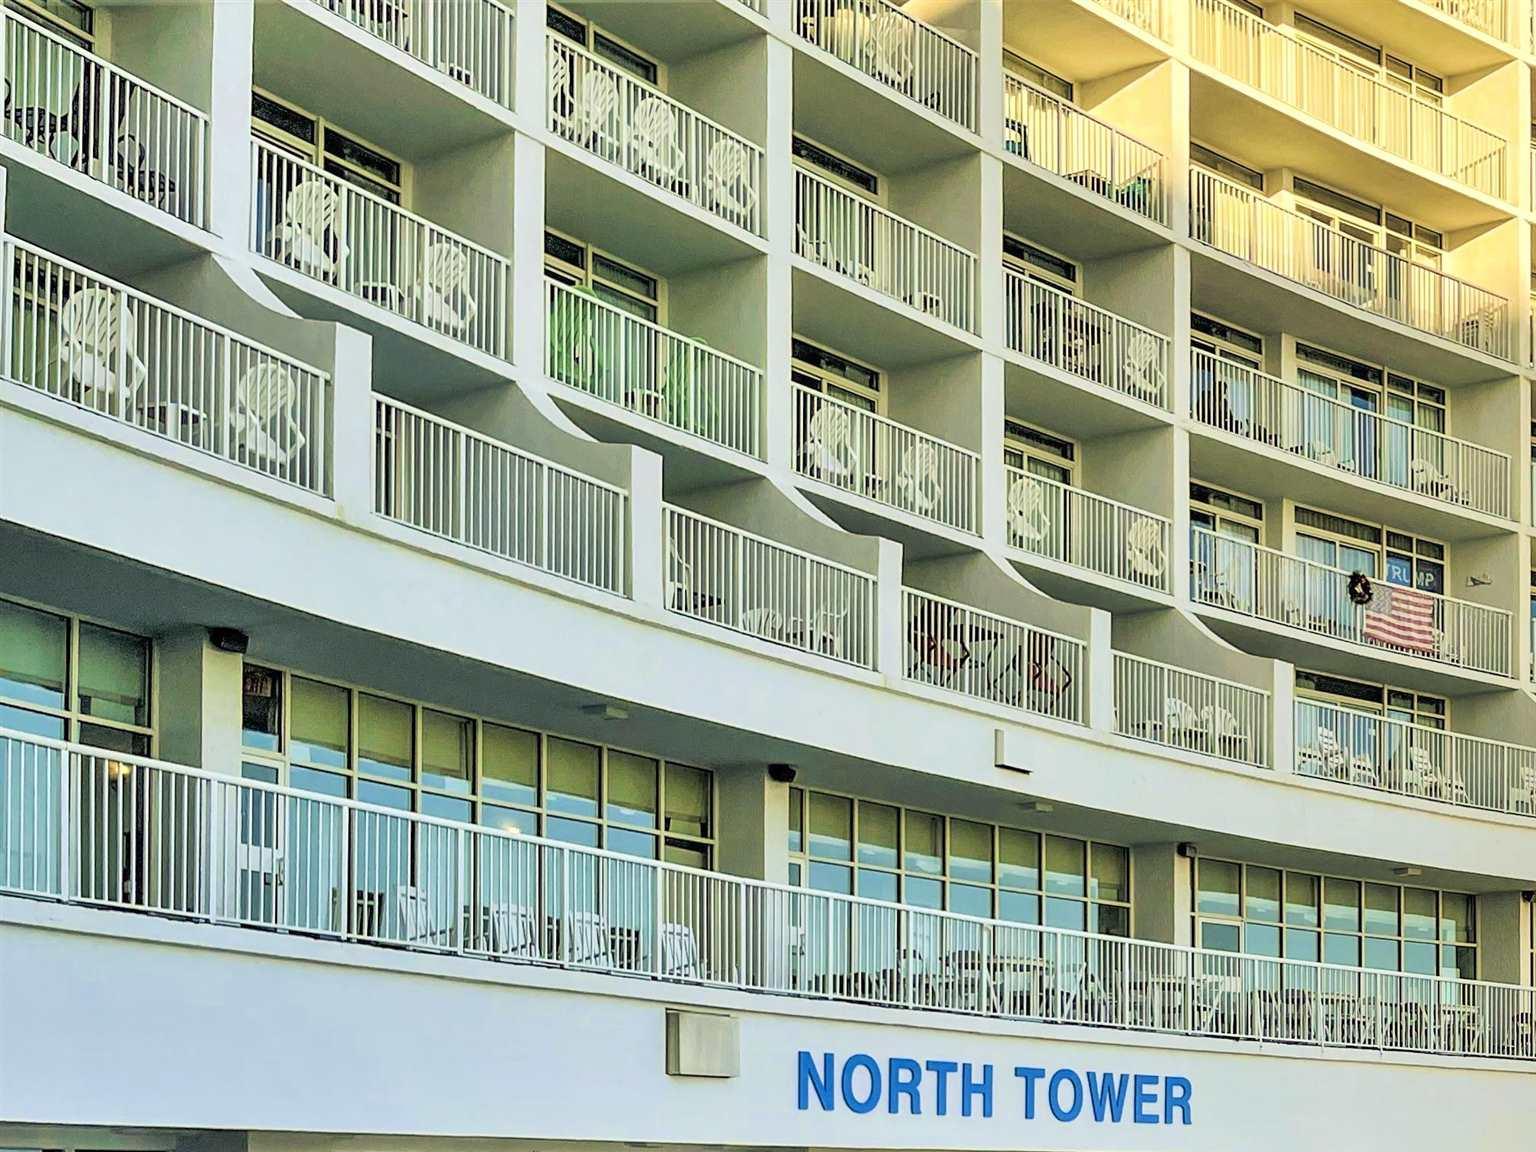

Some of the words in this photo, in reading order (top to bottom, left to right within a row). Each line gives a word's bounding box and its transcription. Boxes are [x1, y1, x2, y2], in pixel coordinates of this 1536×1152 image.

[1386, 563, 1434, 588] RUMP
[797, 1050, 994, 1118] NORTH
[1014, 1066, 1193, 1125] TOWER
